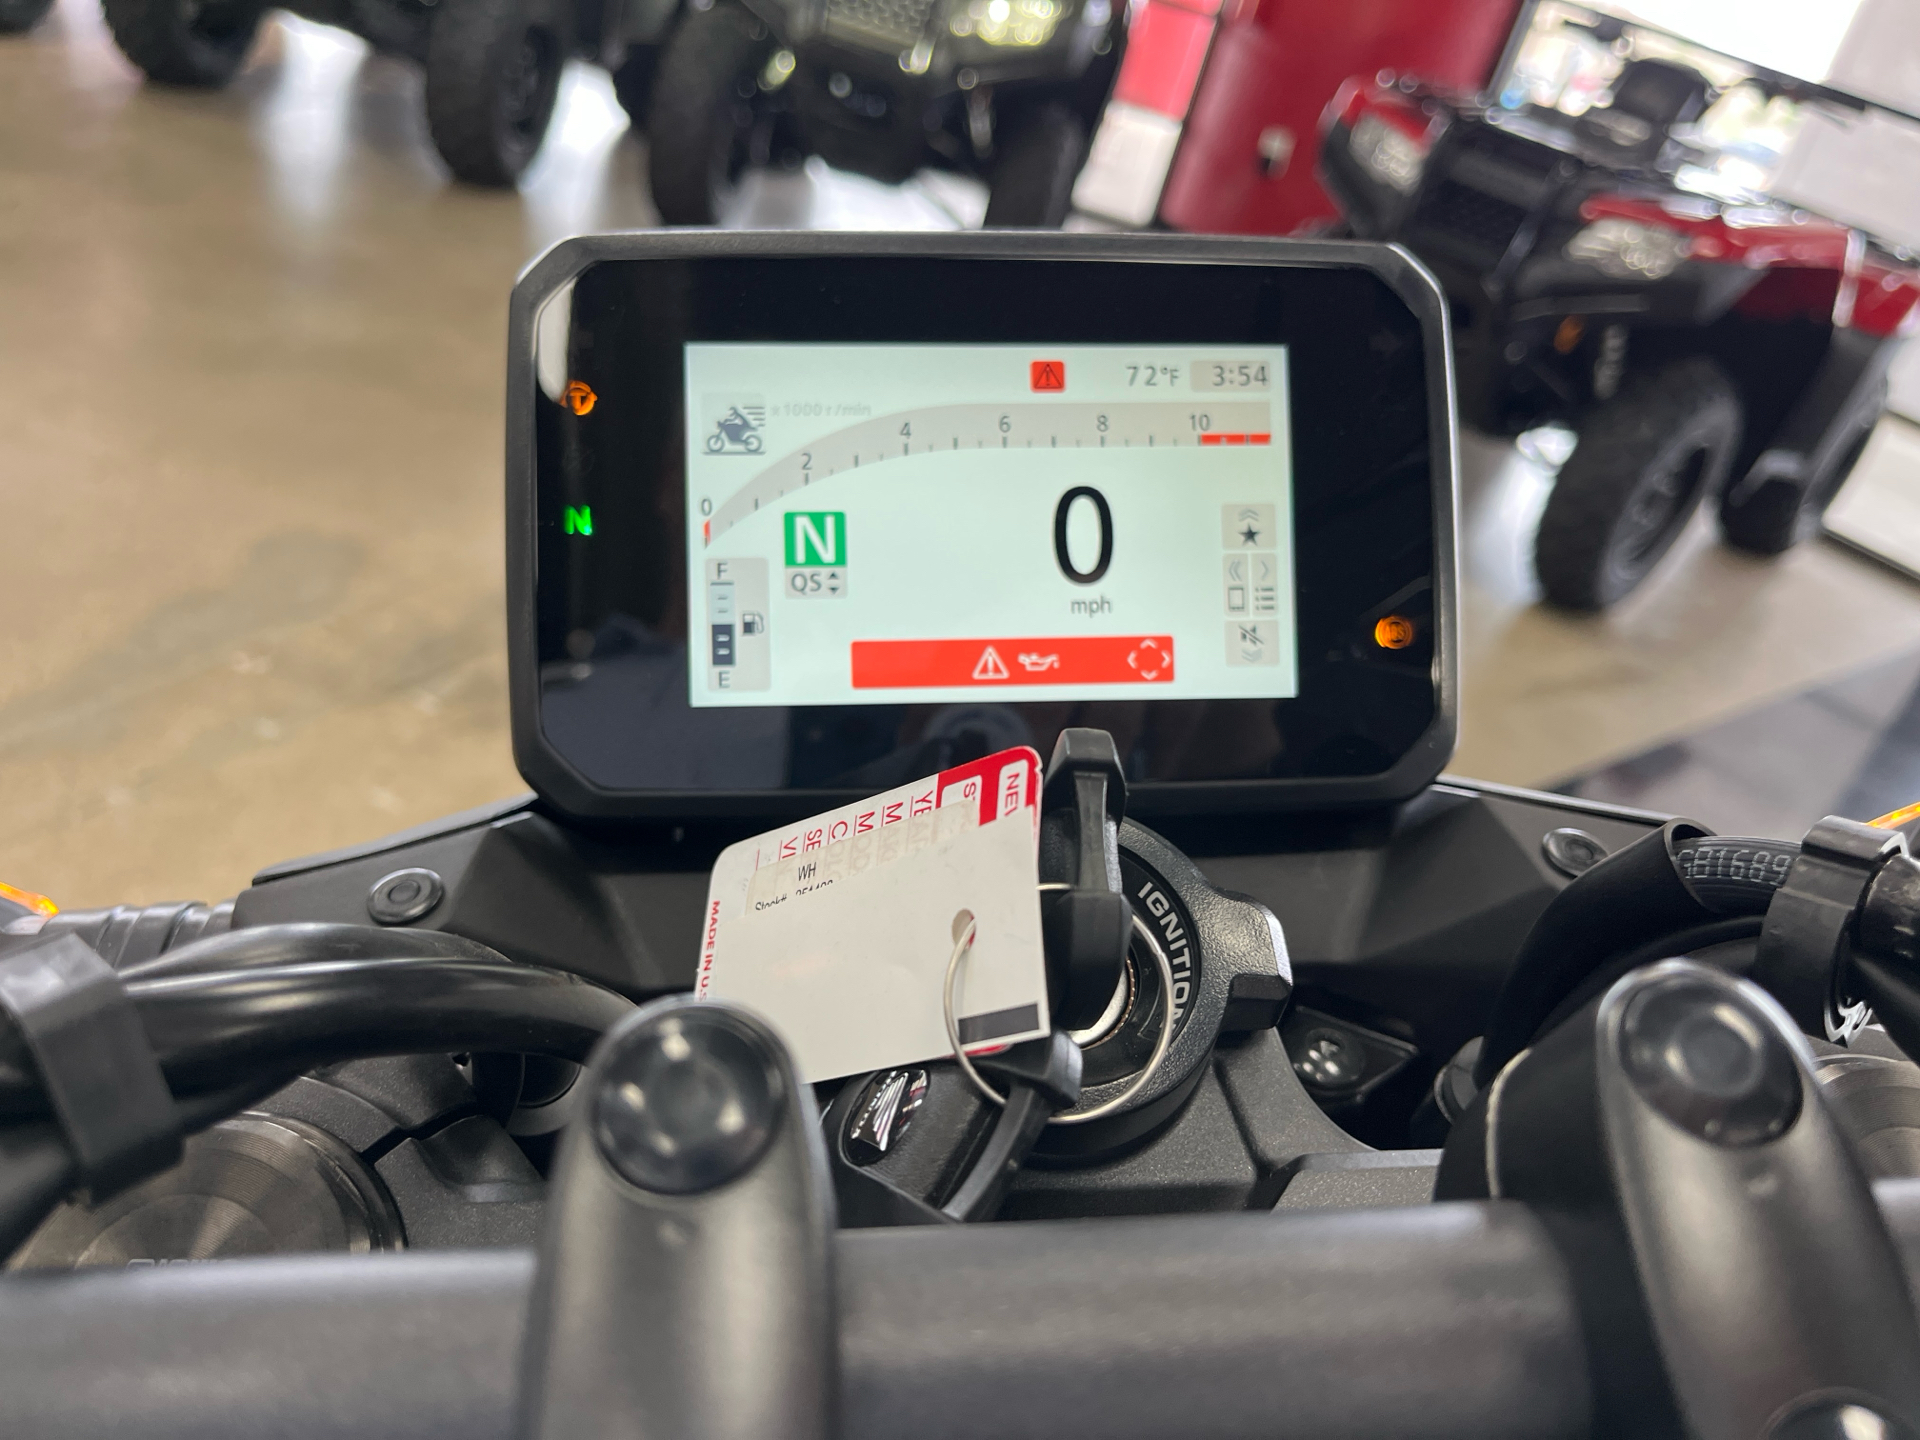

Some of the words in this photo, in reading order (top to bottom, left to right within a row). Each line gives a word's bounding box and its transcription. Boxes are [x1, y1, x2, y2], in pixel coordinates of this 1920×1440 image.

[1212, 365, 1269, 387] 3:54
[899, 422, 912, 440] 4
[998, 415, 1011, 433] 6
[1096, 415, 1109, 433] 8
[1190, 414, 1210, 433] 10
[801, 453, 812, 471] 2
[700, 499, 713, 517] 0
[564, 505, 593, 536] N
[794, 515, 836, 565] N
[1054, 486, 1113, 585] 0
[716, 562, 728, 580] F
[790, 573, 822, 595] QS
[1071, 597, 1113, 618] mph
[718, 671, 731, 688] E
[706, 900, 720, 951] MADE
[703, 953, 713, 971] IN
